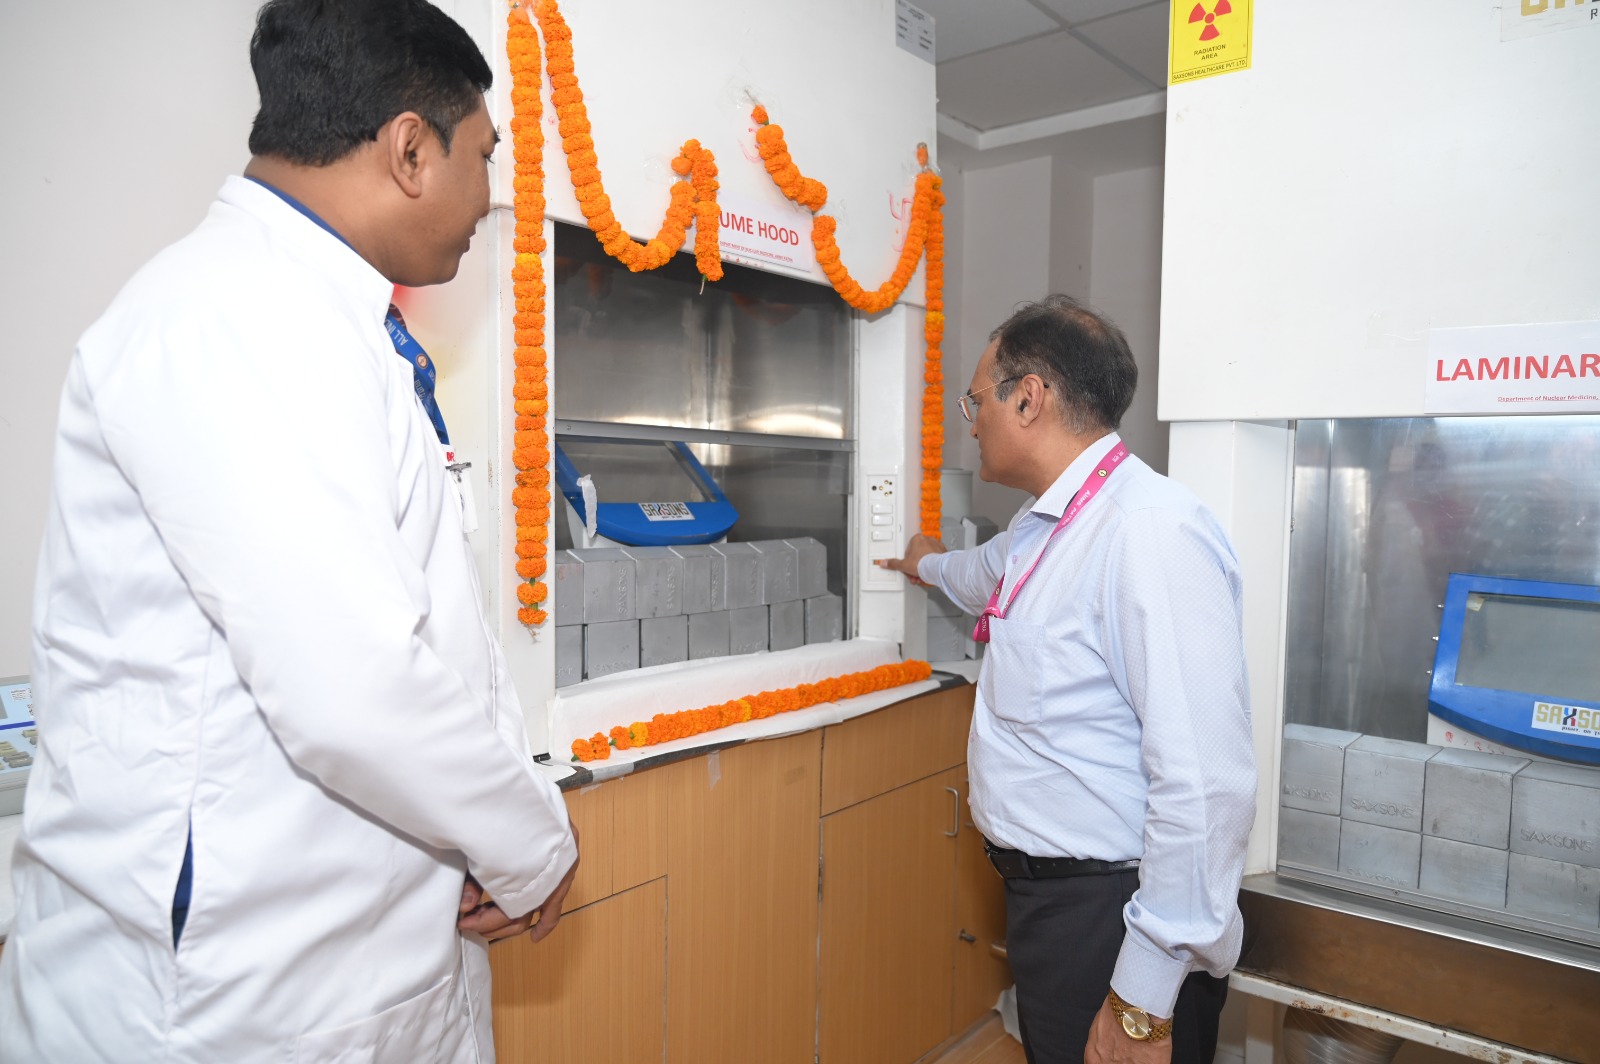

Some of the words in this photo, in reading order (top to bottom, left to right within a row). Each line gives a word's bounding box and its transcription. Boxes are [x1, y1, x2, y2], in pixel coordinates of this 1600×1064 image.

[1194, 44, 1226, 56] RADIATION
[1201, 52, 1218, 61] AREA
[1173, 71, 1195, 80] SAXSONS
[1194, 63, 1225, 75] HEALTHCARE
[719, 210, 754, 236] UME
[757, 220, 799, 246] HOOD
[394, 329, 409, 346] ALL
[1436, 353, 1600, 381] LAMINAR
[1497, 395, 1534, 403] Department
[641, 503, 690, 517] SAXSONS
[1282, 784, 1334, 802] AXSONS
[1350, 798, 1415, 819] SAXSONS
[1520, 828, 1593, 854] SAXSONS
